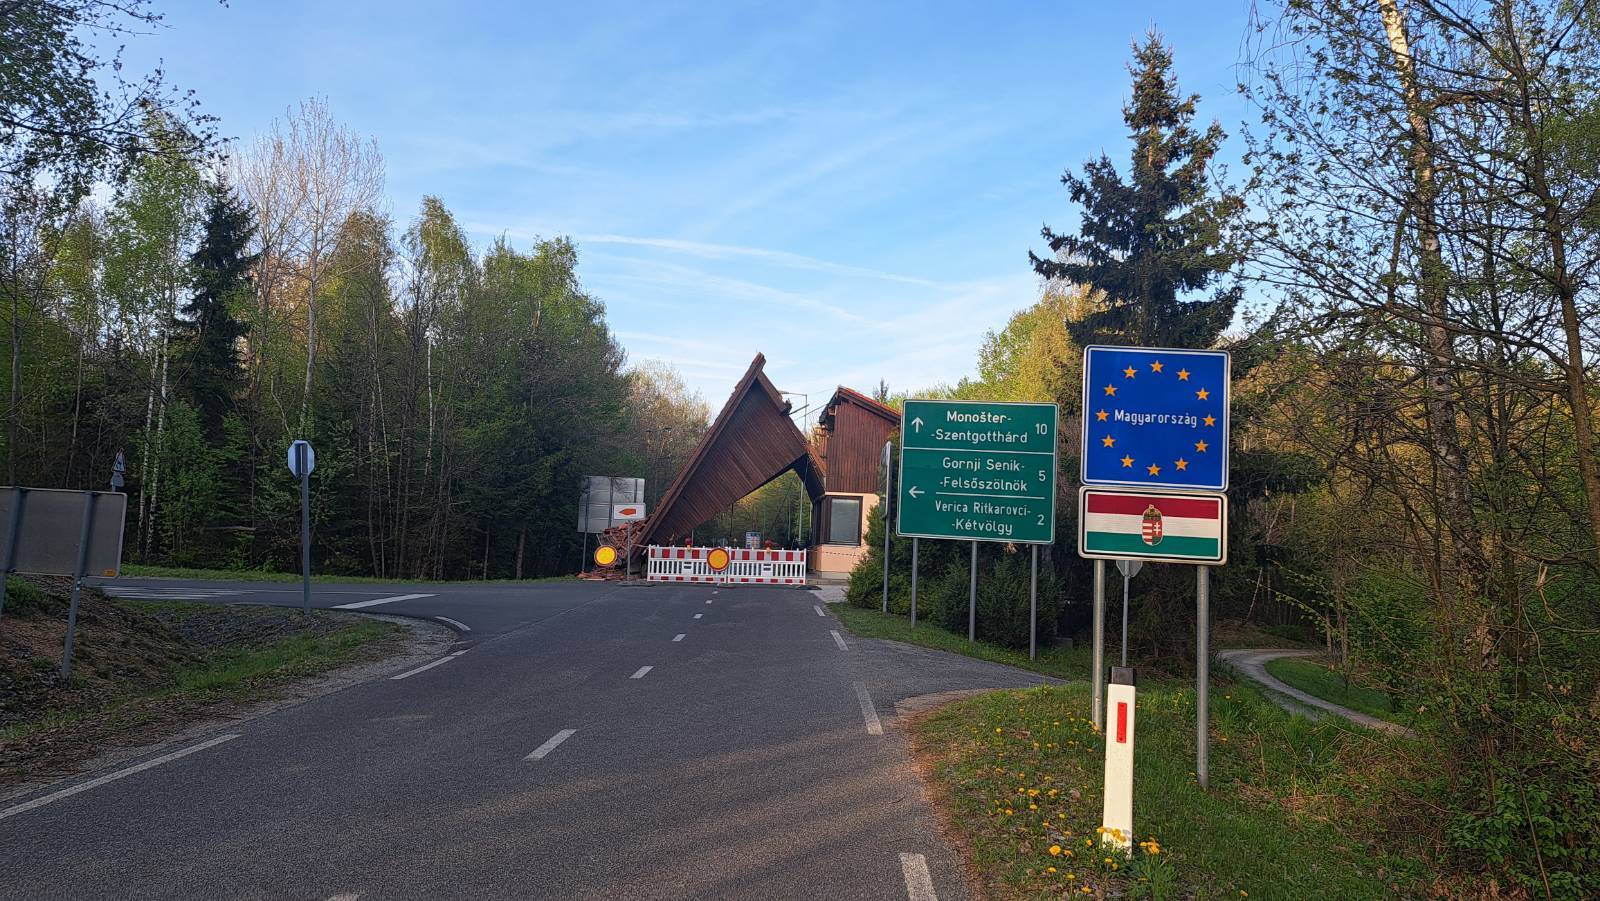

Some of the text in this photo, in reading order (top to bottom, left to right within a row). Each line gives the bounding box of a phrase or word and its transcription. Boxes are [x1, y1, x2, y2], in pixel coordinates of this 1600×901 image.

[946, 410, 1012, 423] Monošter-
[1114, 409, 1198, 428] Magyarország
[1035, 423, 1048, 435] 10
[930, 429, 1028, 444] -Szentgotthárd
[942, 457, 1025, 471] Gornji Senik-
[1038, 470, 1046, 482] 5
[939, 476, 1028, 491] -Felsőszölnök
[935, 500, 1031, 516] Verica Ritkarovci-
[951, 518, 1013, 536] -Kétvölgy
[1037, 515, 1045, 526] 2
